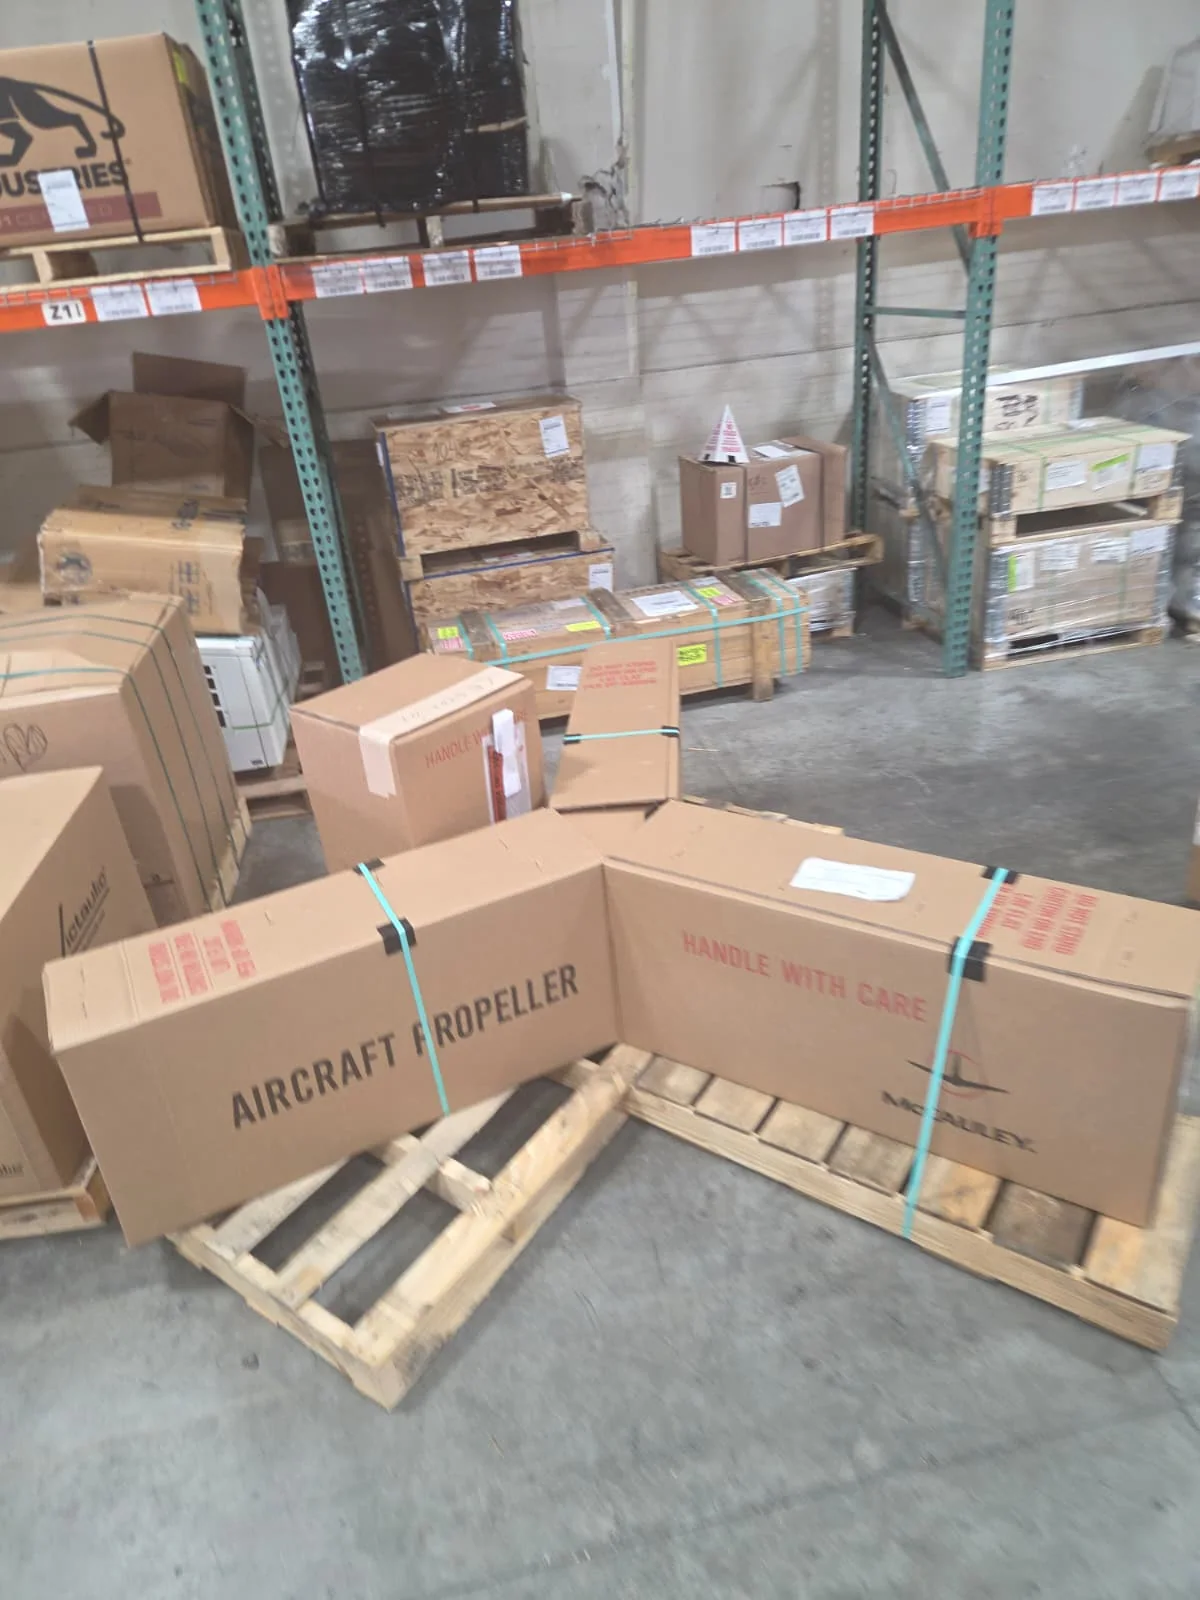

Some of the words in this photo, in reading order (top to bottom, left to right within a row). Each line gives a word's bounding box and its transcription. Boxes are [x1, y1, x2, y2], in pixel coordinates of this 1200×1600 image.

[682, 929, 771, 977] HANDLE
[781, 958, 847, 999] WITH
[857, 981, 928, 1023] CARE
[231, 1031, 397, 1130] AIRCRAFT
[411, 963, 579, 1056] PROPELLER
